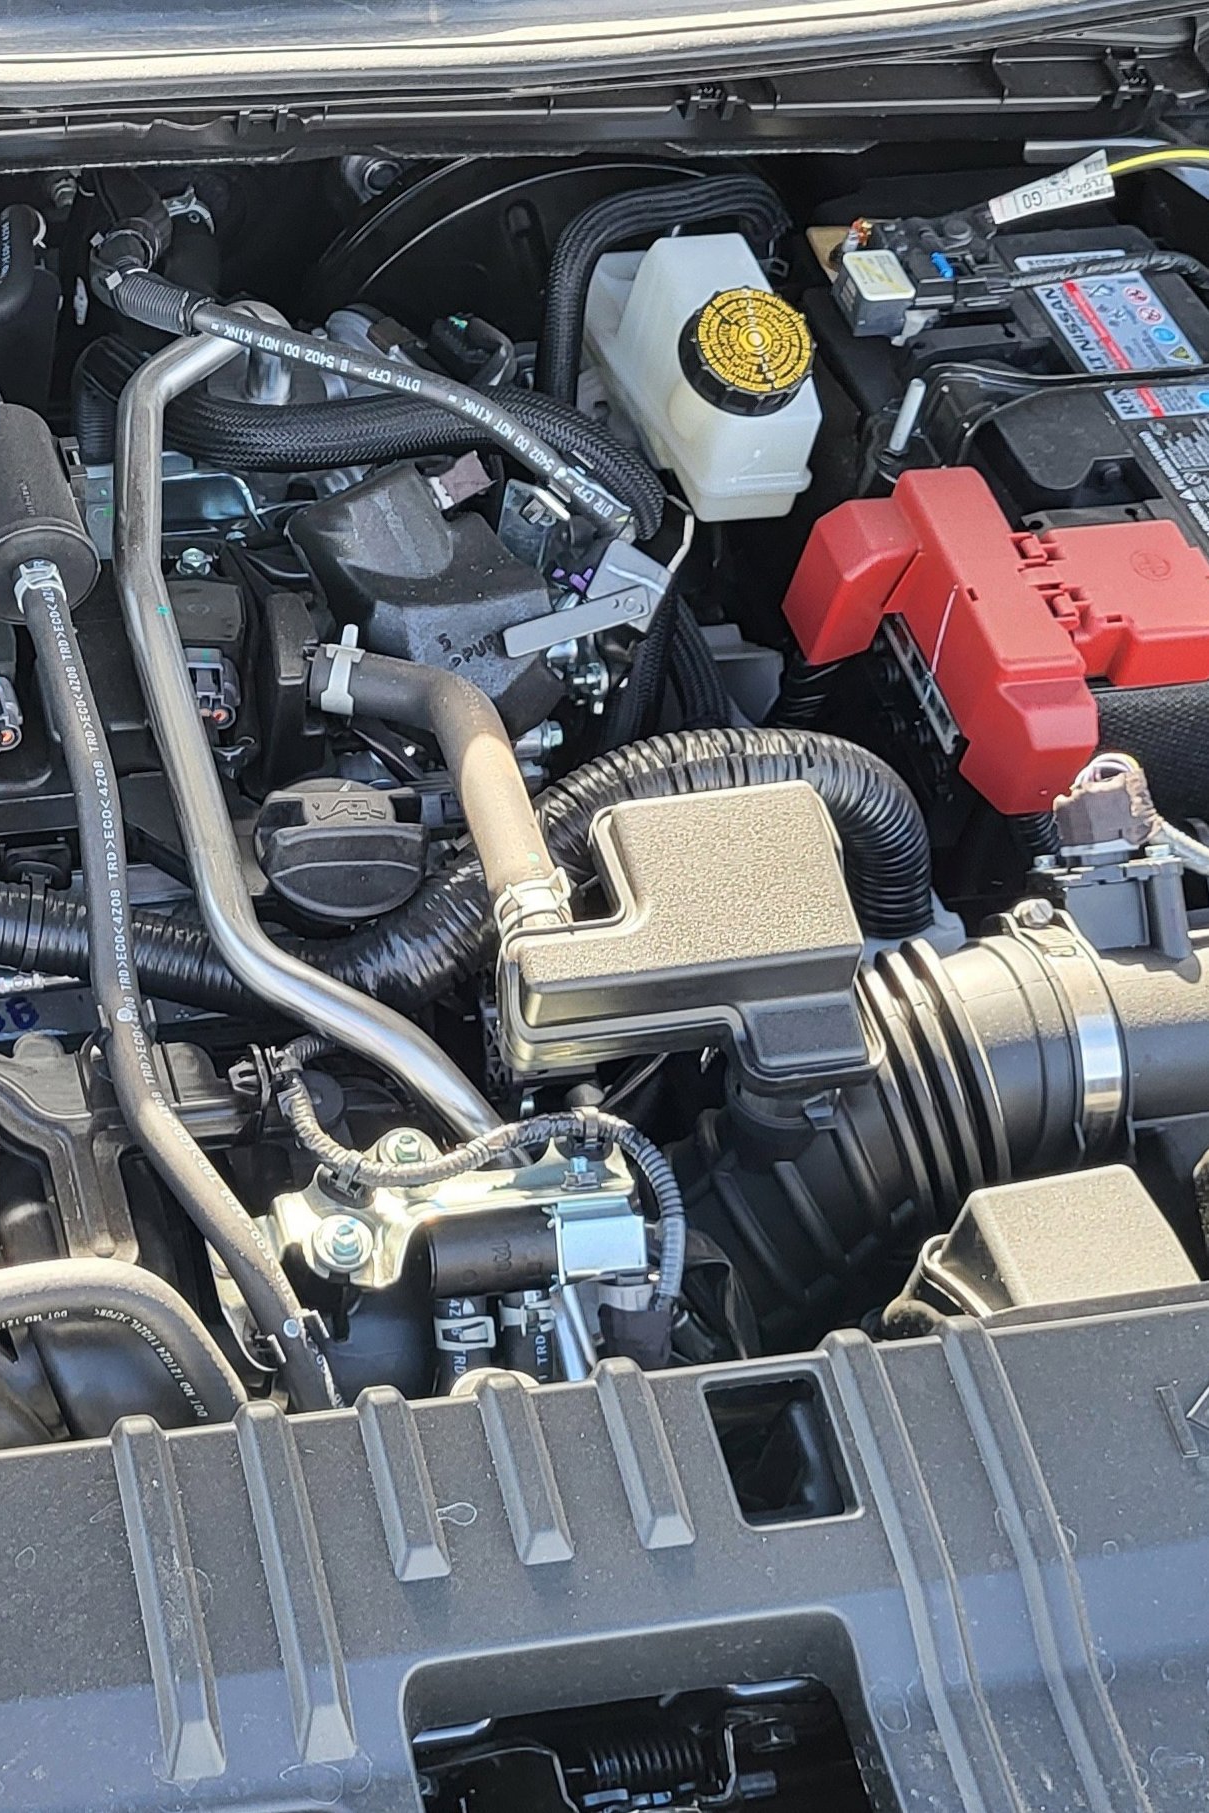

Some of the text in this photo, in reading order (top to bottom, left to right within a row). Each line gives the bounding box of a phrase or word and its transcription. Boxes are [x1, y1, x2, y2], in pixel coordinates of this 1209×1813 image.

[1041, 286, 1091, 354] NISSAN
[223, 325, 252, 346] KINK
[257, 334, 280, 351] NOT
[284, 343, 300, 358] DO
[305, 349, 335, 367] 5402
[368, 367, 391, 386] CFP
[396, 374, 421, 392] DTR
[460, 397, 493, 423] KINK
[492, 418, 515, 439] NOT
[513, 435, 530, 449] DO
[528, 447, 555, 472] 5402
[573, 485, 595, 505] CFP
[189, 1399, 208, 1418] DOT
